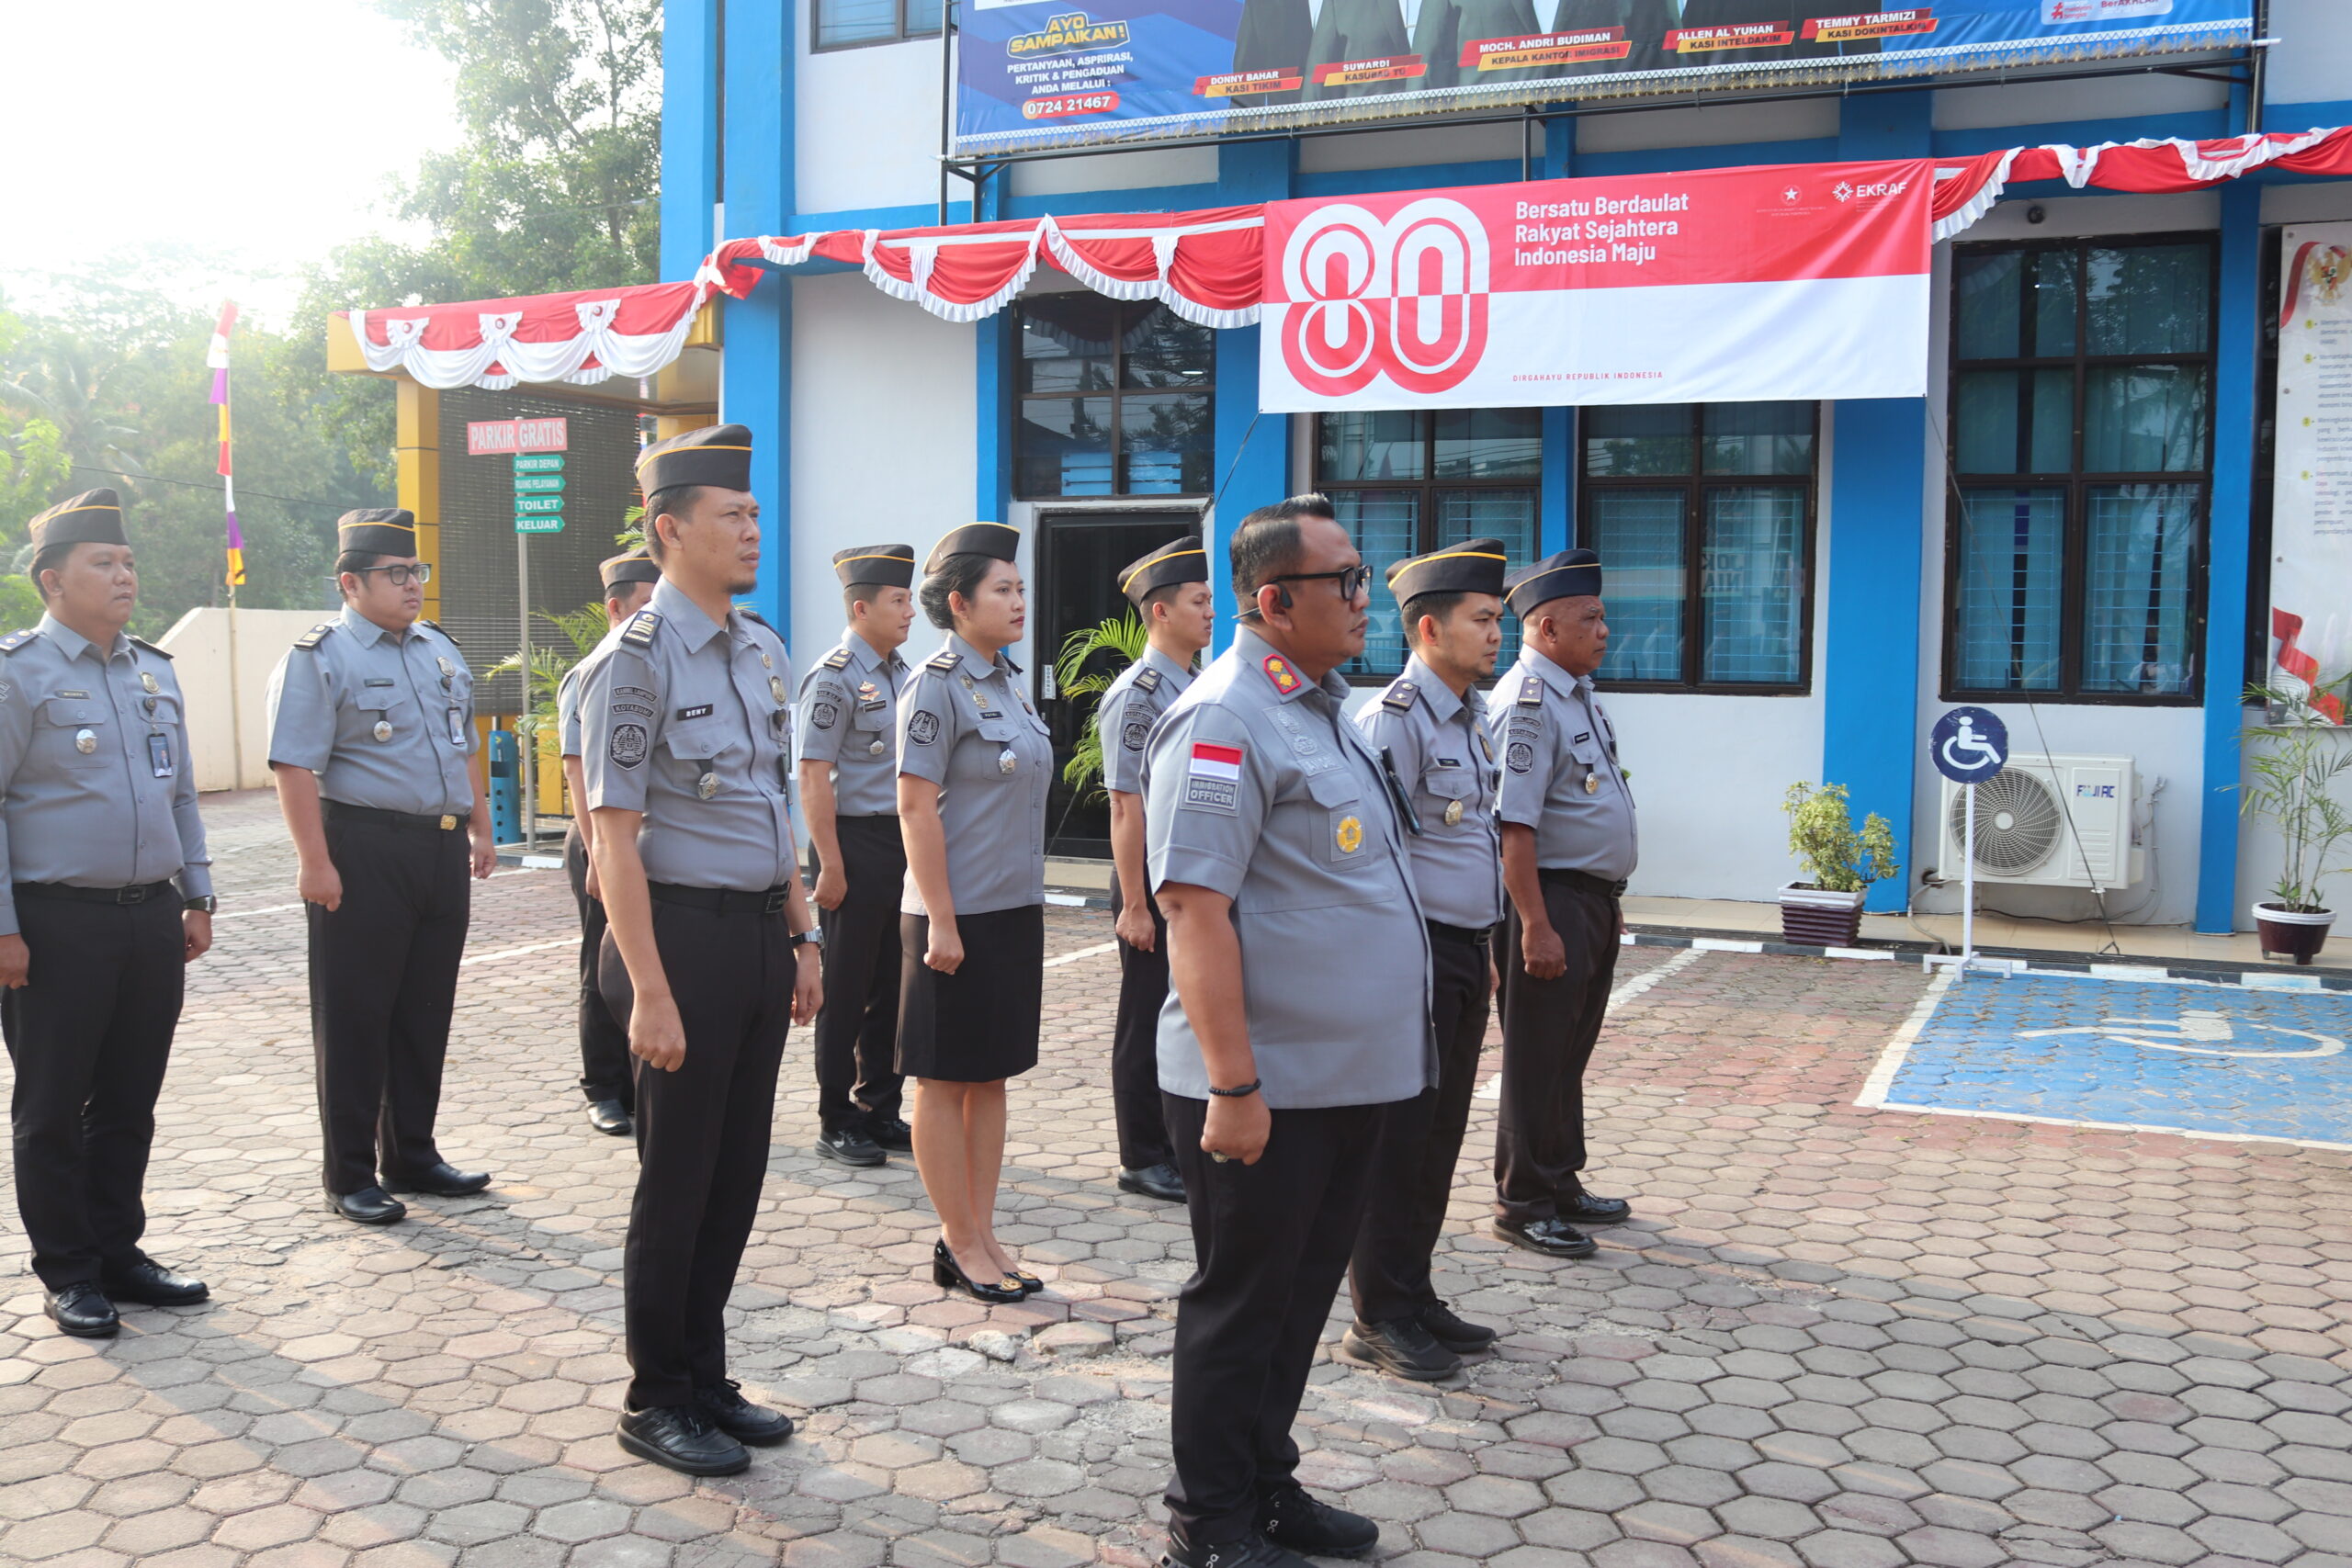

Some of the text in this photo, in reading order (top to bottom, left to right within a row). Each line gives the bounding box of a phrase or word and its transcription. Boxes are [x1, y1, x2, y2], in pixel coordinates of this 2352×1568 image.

[1048, 17, 1085, 33] AYO
[1815, 11, 1916, 29] TEMMY TARMIZI
[1677, 25, 1774, 40] ALLEN AL YUHAN
[1827, 28, 1851, 39] KASI
[1479, 32, 1611, 53] MOCH. ANDRI BUDIMAN
[1690, 34, 1781, 50] KASI INTELDAKIM
[1007, 51, 1134, 73] PERTANYAAN, ASPRIRASI,
[1491, 55, 1529, 65] KEPALA
[1575, 46, 1620, 57] IMIGRASI
[1342, 60, 1390, 72] SUWARDI
[1015, 65, 1125, 85] KRITIK & PENGADUAN
[1211, 71, 1279, 85] DONNY BAHAR
[1032, 83, 1059, 95] ANDA
[1225, 81, 1282, 94] KASI TIKIM
[1027, 96, 1111, 115] 0724 21467
[1856, 182, 1907, 197] EKRAF
[1516, 193, 1689, 220] Bersatu Berdaulat
[1516, 219, 1679, 246] Rakyat Sejahtera
[1515, 242, 1656, 266] Indonesia Maju
[1282, 198, 1490, 397] 80
[1512, 371, 1663, 382] DIRGAHAYU REPUBLIK INDONESIA
[471, 421, 564, 450] PARKIR GRATIS
[515, 459, 538, 469] PARKIR
[517, 500, 559, 510] TOILET
[516, 520, 559, 530] KELUAR
[615, 705, 652, 716] KOTABUMI
[1190, 790, 1233, 805] OFFICER
